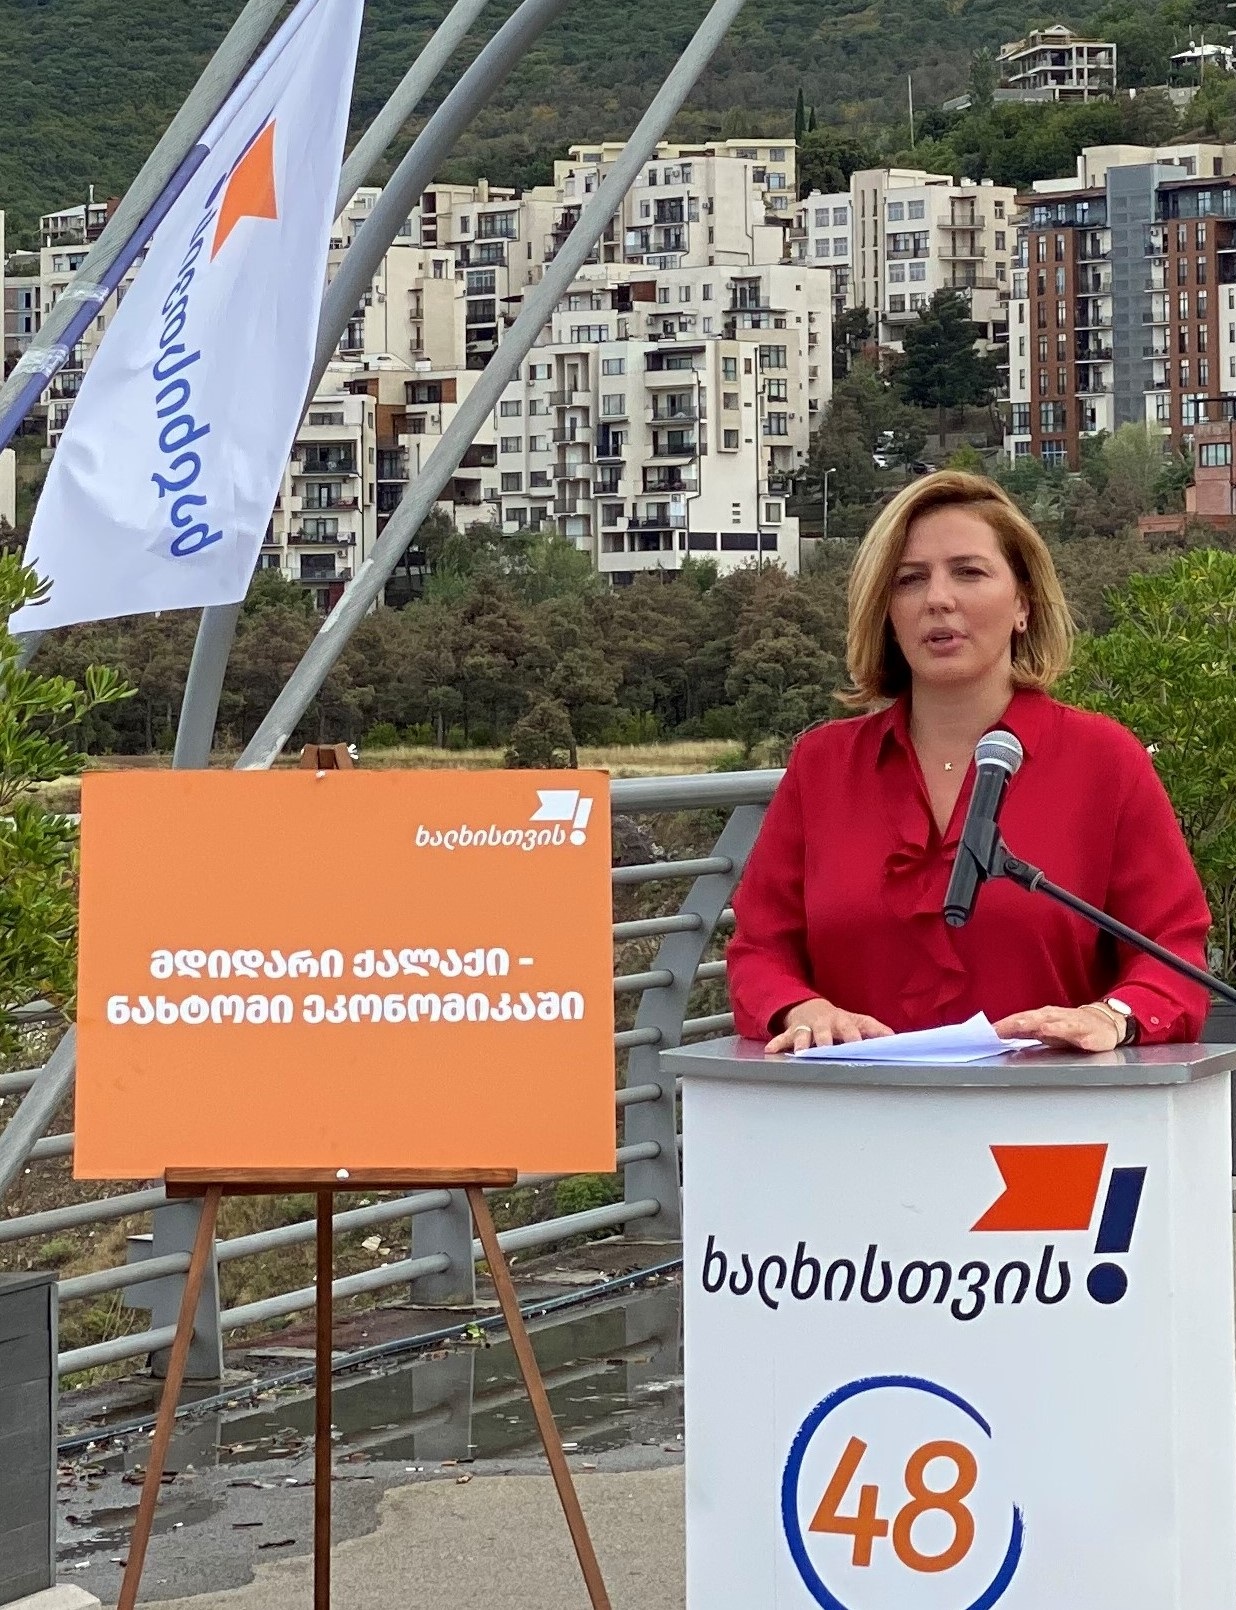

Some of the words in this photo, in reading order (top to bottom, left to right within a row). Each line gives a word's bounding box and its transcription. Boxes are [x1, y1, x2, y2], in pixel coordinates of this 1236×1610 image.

[149, 948, 344, 980] მდიდარი
[352, 947, 510, 979] ქალაქი
[107, 993, 294, 1025] ნახტომი
[302, 991, 586, 1023] ეკონომიკაში
[808, 1436, 978, 1573] 48
